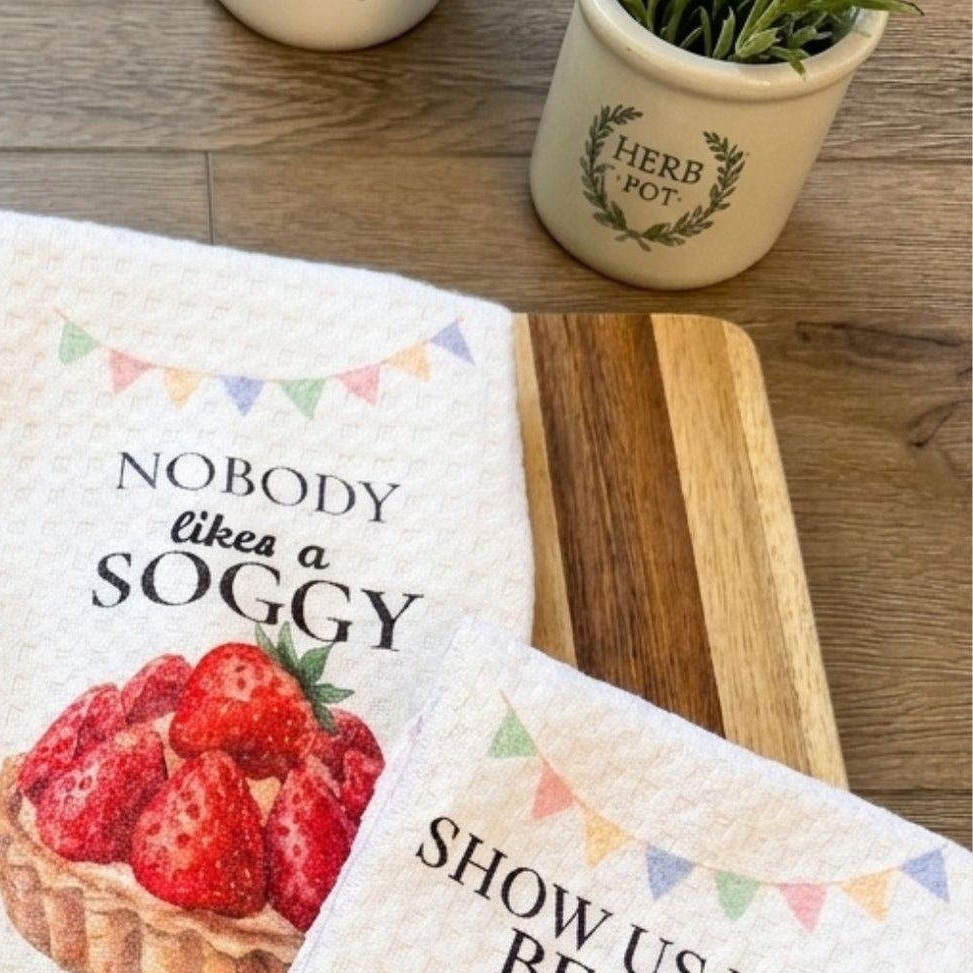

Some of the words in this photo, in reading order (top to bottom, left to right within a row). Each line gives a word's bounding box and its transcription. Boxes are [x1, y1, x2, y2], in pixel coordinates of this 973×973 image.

[612, 135, 704, 184] HERB
[116, 451, 401, 523] NOBODY
[170, 510, 276, 557] likes
[297, 545, 330, 570] a
[92, 550, 425, 652] SOGGY
[415, 816, 613, 950] SHOW
